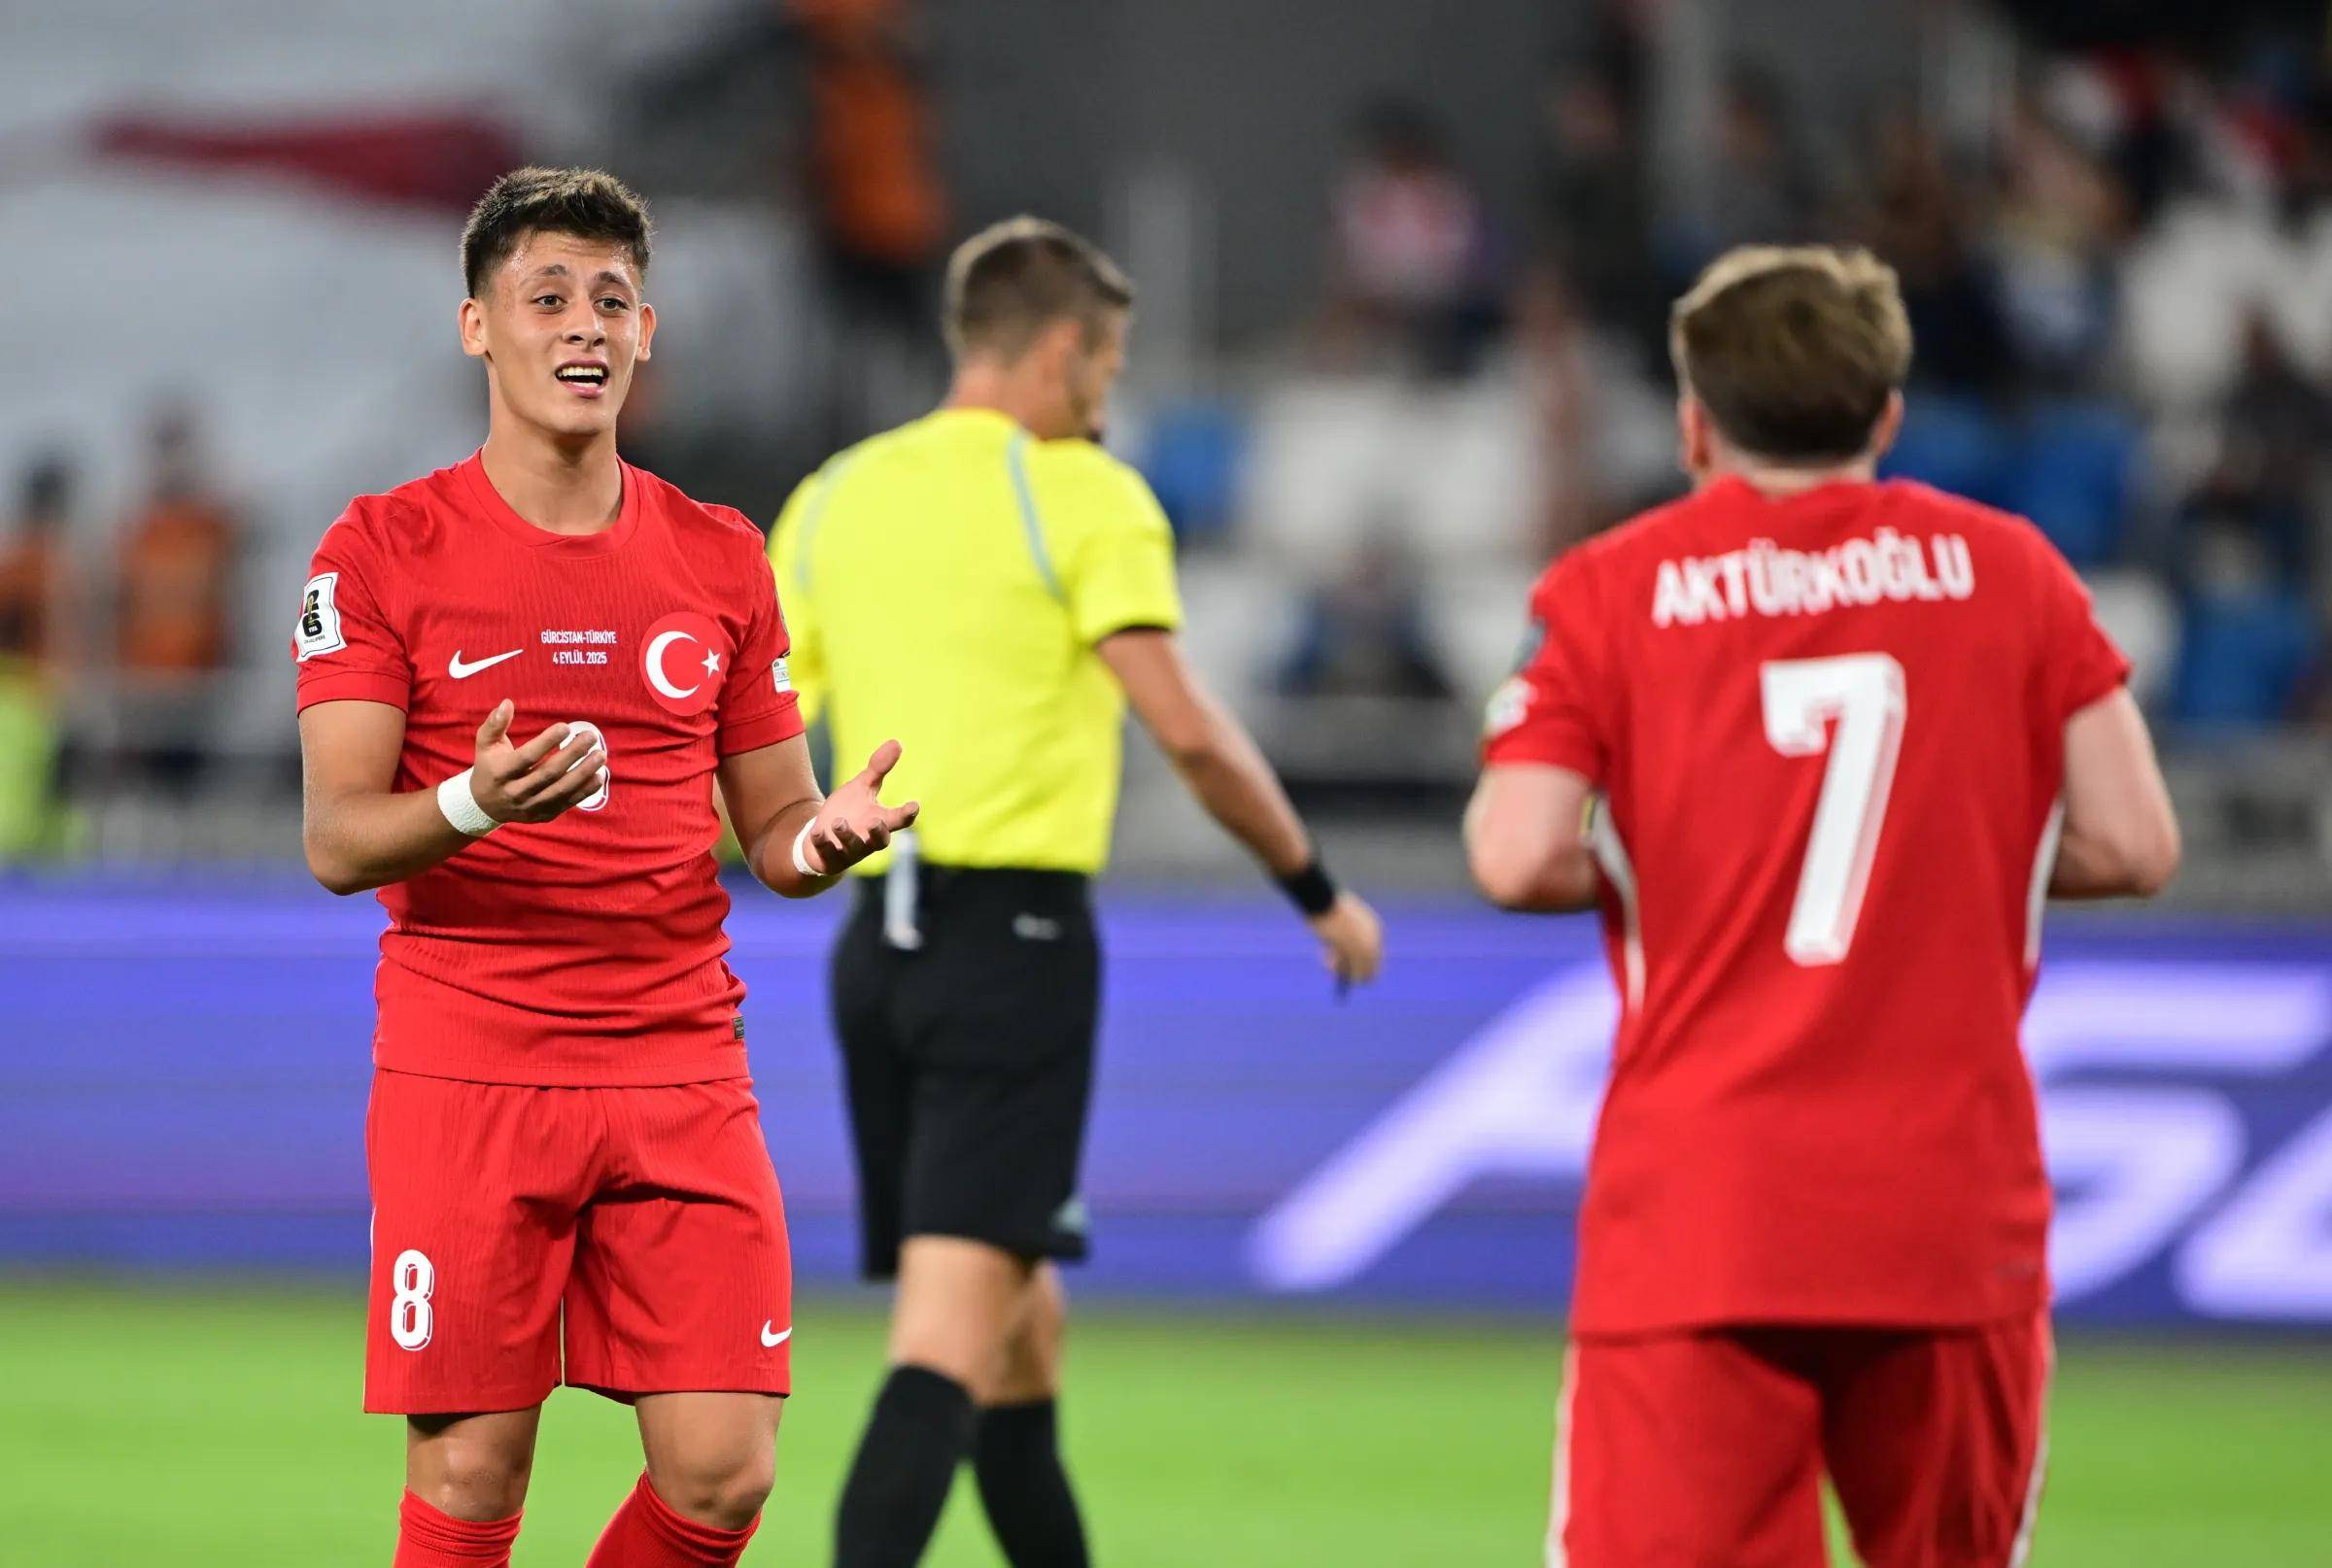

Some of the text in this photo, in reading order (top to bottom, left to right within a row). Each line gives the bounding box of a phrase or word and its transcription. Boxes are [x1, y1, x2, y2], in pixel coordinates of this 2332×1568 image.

[1653, 528, 1975, 628] AKTÜRKOĞLU
[552, 649, 607, 664] 4 EYLÜL 2025
[1760, 652, 1907, 967] 7
[391, 1248, 434, 1351] 8
